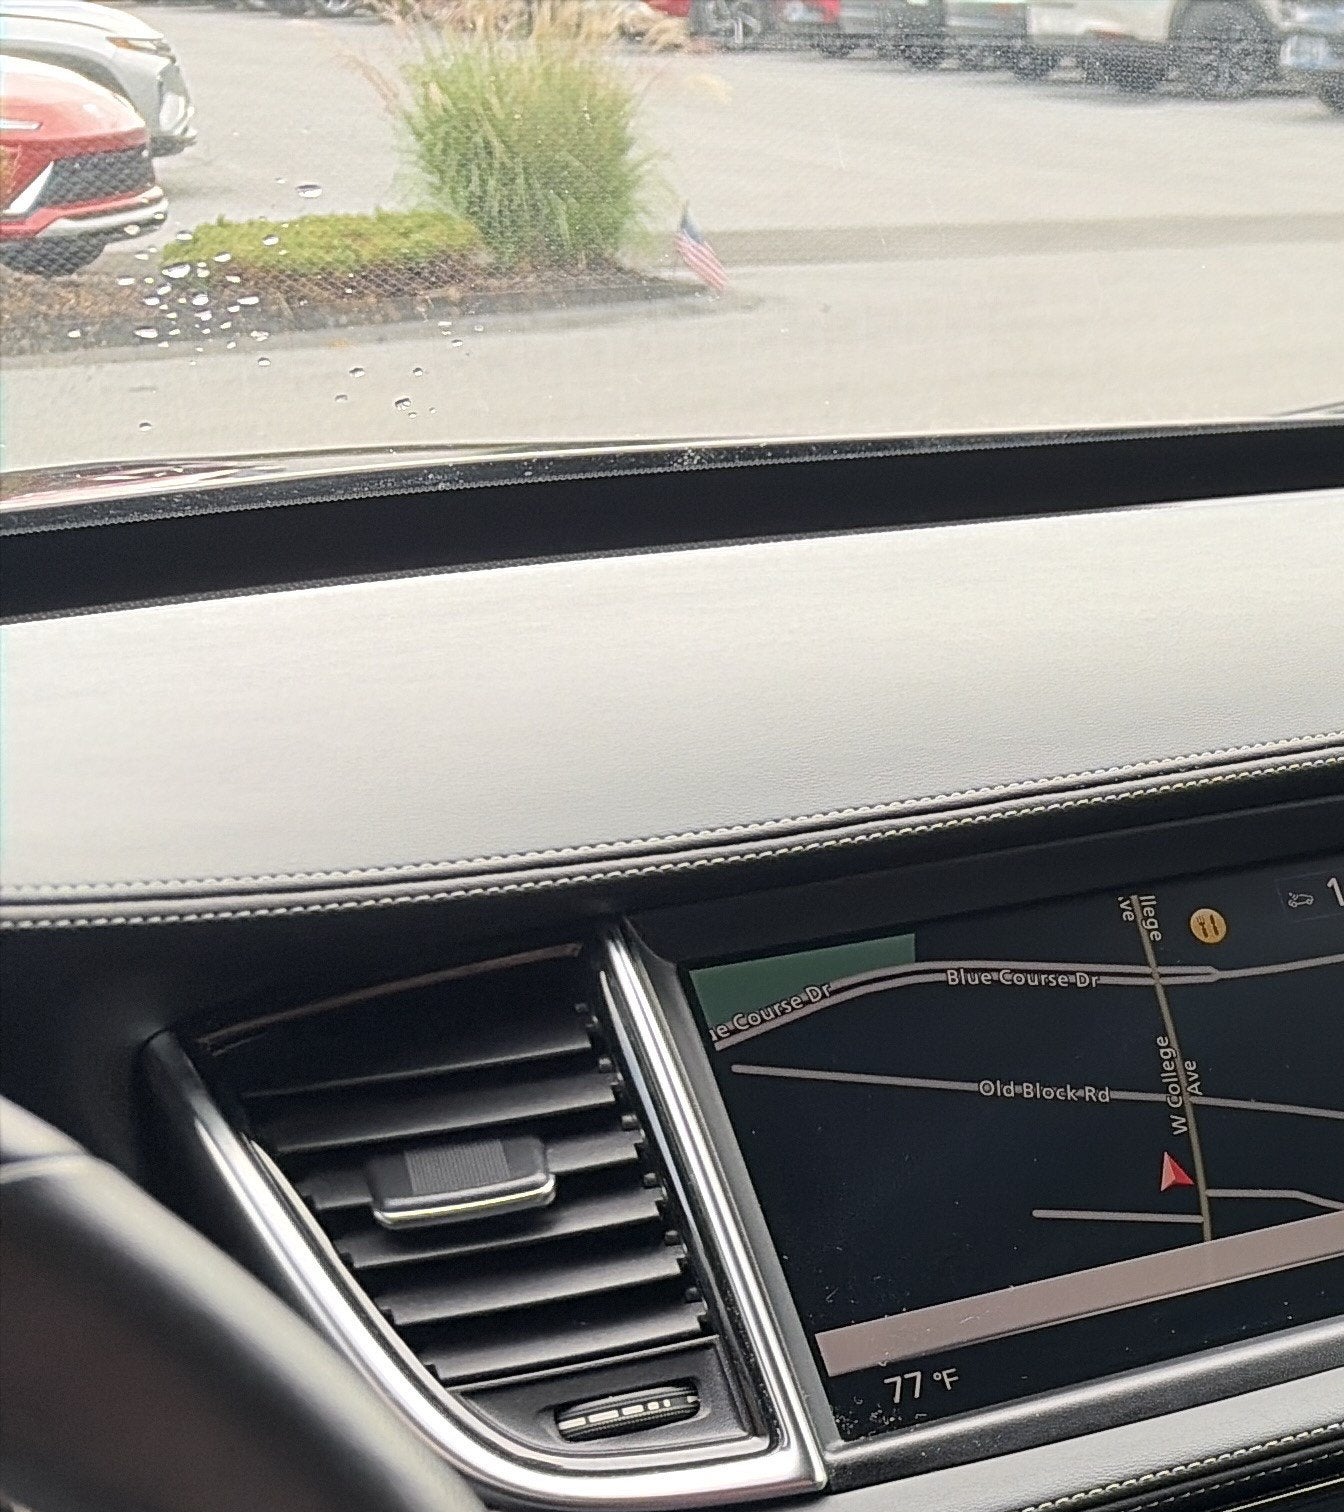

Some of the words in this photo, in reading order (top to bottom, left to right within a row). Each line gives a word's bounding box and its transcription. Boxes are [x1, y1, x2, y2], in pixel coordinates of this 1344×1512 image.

[1118, 896, 1135, 922] ve
[947, 969, 992, 986] Blue
[1000, 970, 1069, 987] Course
[1076, 972, 1099, 989] Dr
[732, 994, 804, 1031] Course
[805, 982, 832, 1003] Dr
[1156, 1036, 1184, 1109] College
[1186, 1059, 1203, 1096] Ave
[978, 1080, 1014, 1097] Old
[1023, 1081, 1079, 1101] Block
[1085, 1084, 1110, 1103] Rd
[1173, 1114, 1189, 1135] W
[884, 1371, 922, 1403] 77
